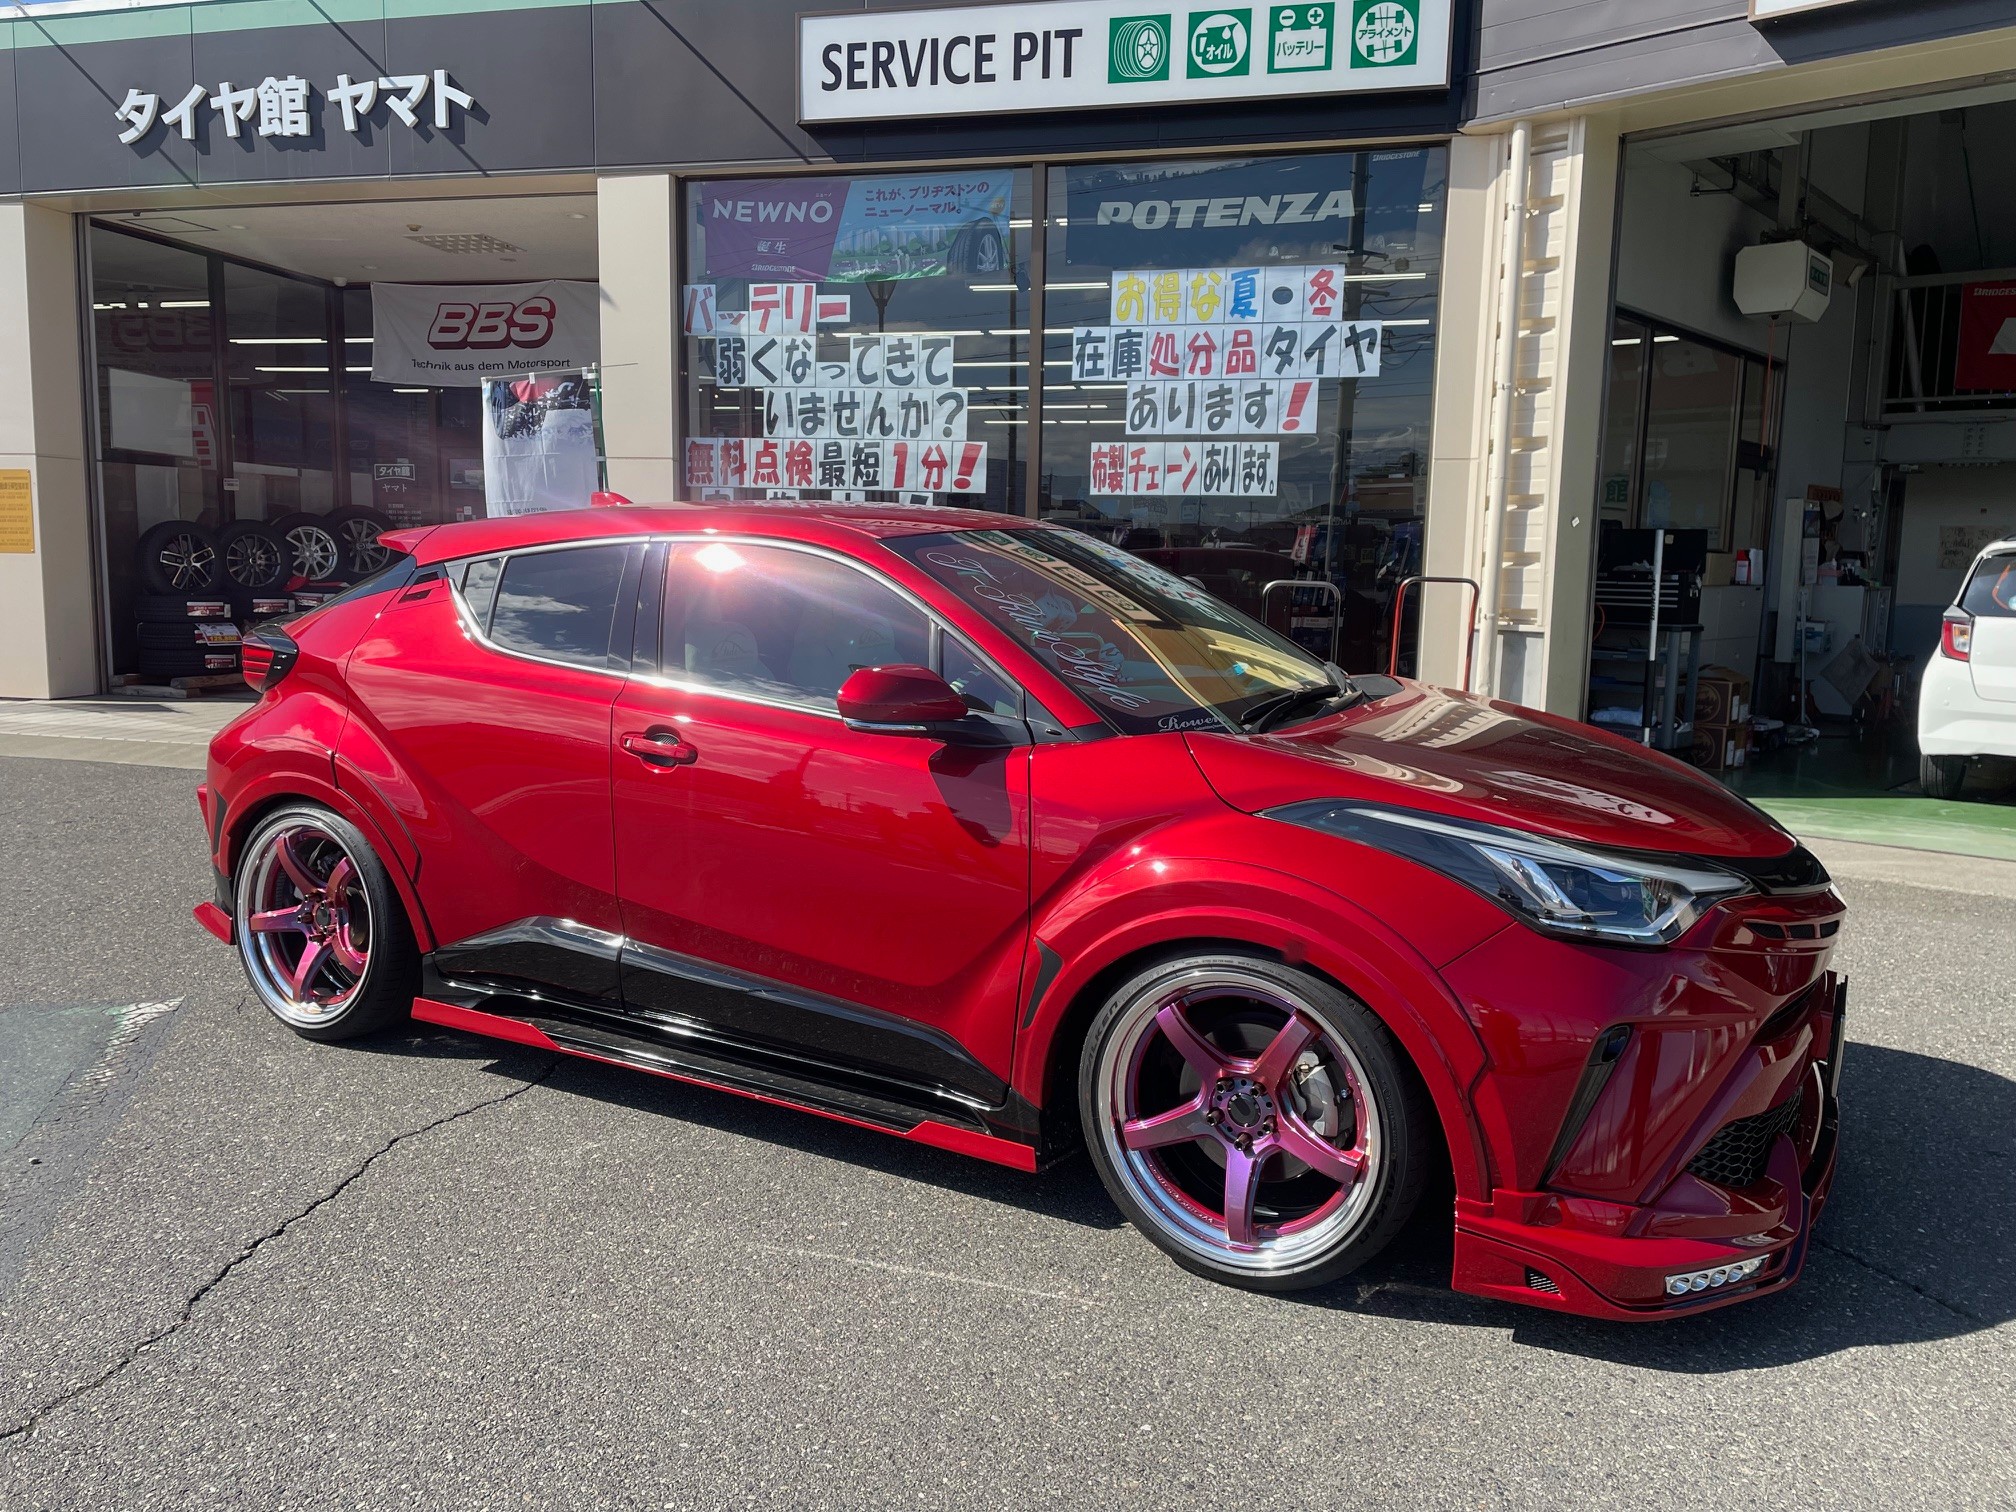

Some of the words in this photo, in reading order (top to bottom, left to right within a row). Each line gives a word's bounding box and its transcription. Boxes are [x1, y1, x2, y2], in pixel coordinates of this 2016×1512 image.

[1205, 43, 1234, 61] オイル
[1276, 40, 1325, 57] バッテリー
[1357, 25, 1413, 41] アライメント
[821, 34, 996, 91] SERVICE
[1013, 28, 1083, 80] PIT
[115, 76, 309, 145] タイヤ館
[327, 69, 474, 132] ヤマト
[712, 199, 832, 223] NEWNO
[865, 182, 989, 201] これが、ブリヂストンの
[865, 202, 961, 217] ニューノーマル。
[1097, 190, 1355, 230] POTENZA
[685, 285, 847, 333] バッテリー
[1116, 268, 1337, 322] お得な夏・冬
[428, 296, 556, 350] BBS
[412, 359, 451, 371] Technik
[454, 362, 475, 371] aus
[478, 361, 502, 371] dem
[507, 359, 571, 371] Motorsport
[718, 338, 951, 385] 弱くなってきて
[1076, 324, 1377, 378] 在庫処分品タイヤ
[766, 391, 964, 437] いませんか？
[1130, 383, 1313, 431] あります！
[382, 484, 408, 493] ヤマト
[1092, 444, 1275, 494] 布製チェーンあります。
